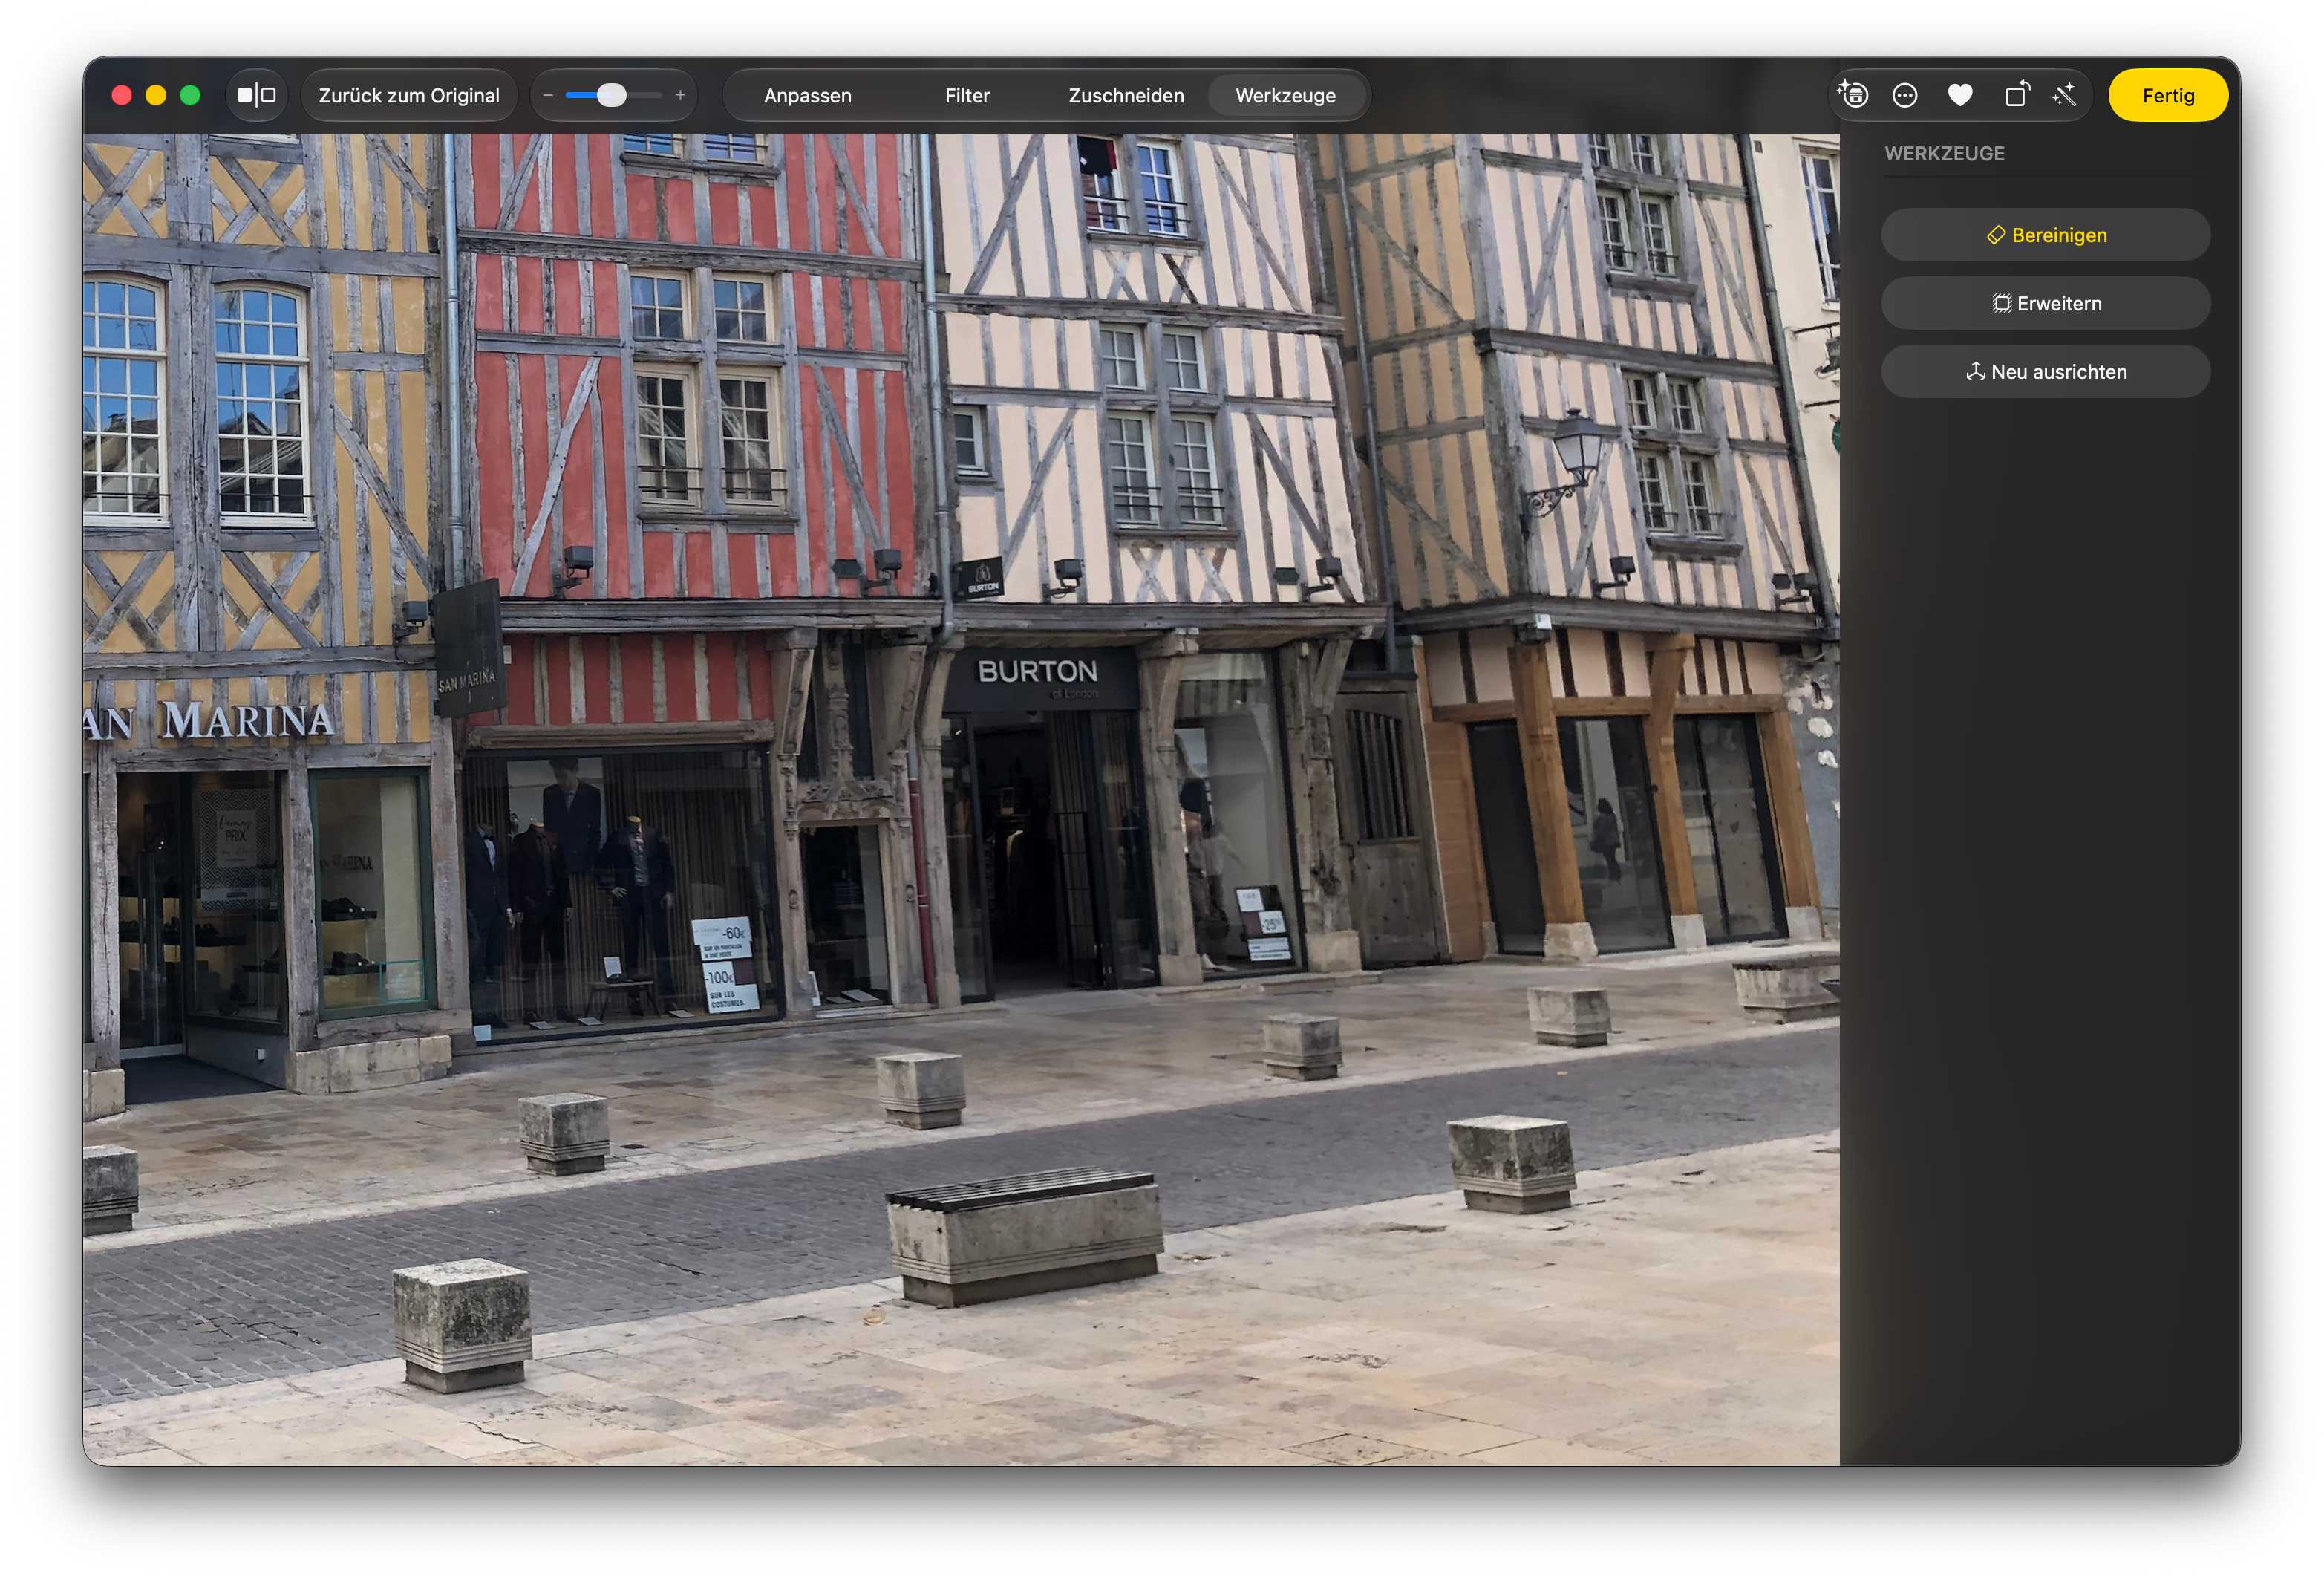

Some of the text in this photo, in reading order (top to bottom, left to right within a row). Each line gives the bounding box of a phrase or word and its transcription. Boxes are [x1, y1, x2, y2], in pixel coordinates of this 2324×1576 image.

[319, 87, 500, 107] Zurück zum Original
[763, 88, 852, 107] Anpassen
[946, 87, 991, 103] Filter
[1068, 87, 1184, 103] Zuschneiden
[1236, 87, 1336, 107] Werkzeuge
[2143, 87, 2196, 107] Fertig
[1884, 146, 2005, 161] WERKZEUGE
[2013, 226, 2107, 249] Bereinigen
[2018, 295, 2102, 311] Erweitern
[1992, 363, 2127, 380] Neu ausrichten
[967, 582, 999, 593] BURTON
[438, 669, 496, 693] SAN MARINA
[978, 660, 1098, 683] BURTON
[160, 700, 335, 738] MARINA
[225, 829, 247, 842] PRIX
